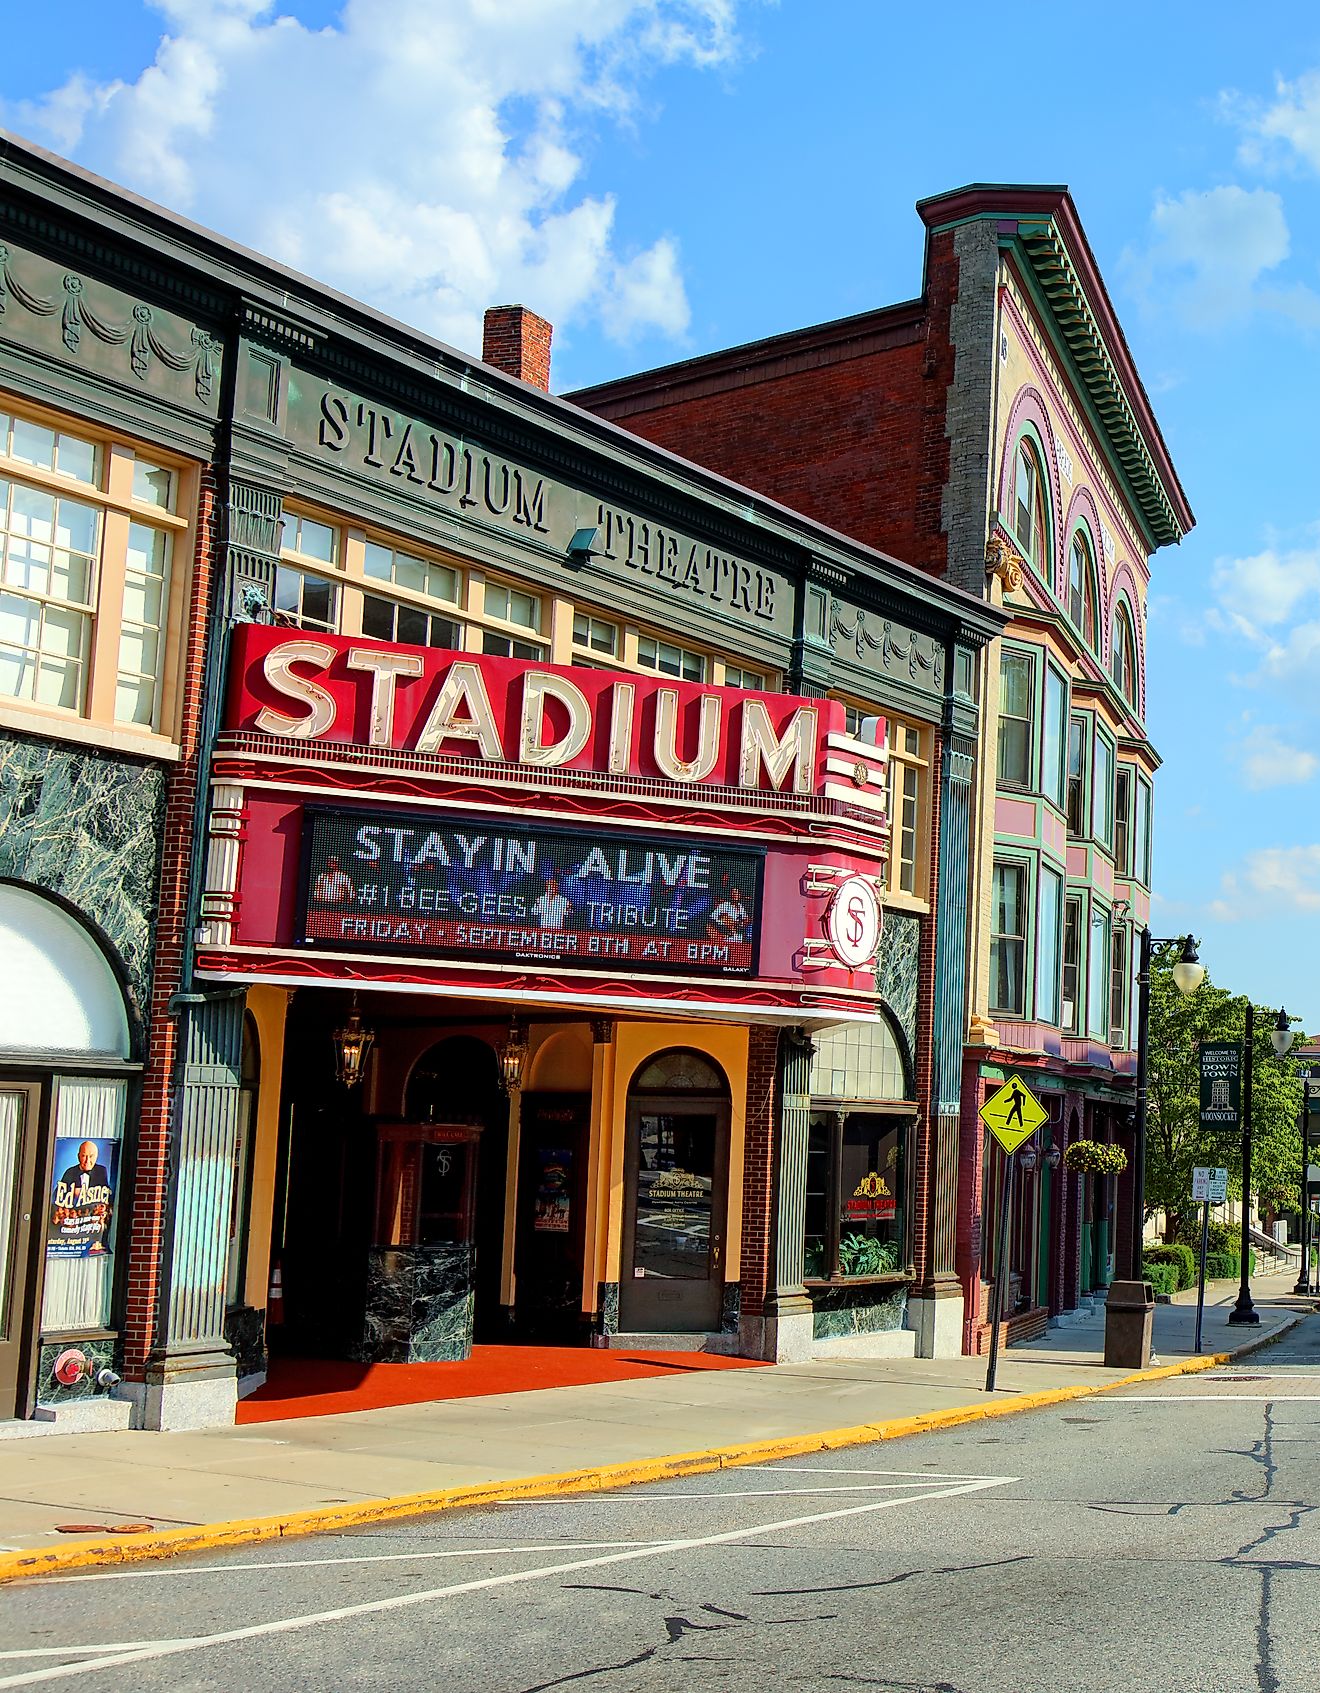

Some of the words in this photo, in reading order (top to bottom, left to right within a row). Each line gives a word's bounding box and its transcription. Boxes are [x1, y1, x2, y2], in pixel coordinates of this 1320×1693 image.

[318, 391, 551, 534] STADIUM
[597, 504, 776, 622] THEATRE
[253, 638, 820, 794] STADIUM
[353, 825, 536, 874] STAYIN
[577, 846, 711, 889] ALIVE
[357, 884, 389, 907] #1
[400, 886, 450, 912] BEE
[458, 892, 526, 918] GEES
[586, 900, 689, 931] TRIBUTE
[341, 918, 429, 940] FRIDAY
[456, 924, 578, 951] SEPTEMBER
[588, 936, 630, 954] 8TH
[642, 940, 672, 957] AT
[687, 943, 730, 962] 8PM
[515, 952, 561, 960] DAKTRONICS
[1202, 1055, 1239, 1063] HISTORIC
[1200, 1112, 1238, 1121] WOONSOCKET
[55, 1181, 76, 1209] Ed
[76, 1183, 113, 1208] Asner
[648, 1190, 677, 1198] STADIUM
[677, 1190, 704, 1198] THEATRE
